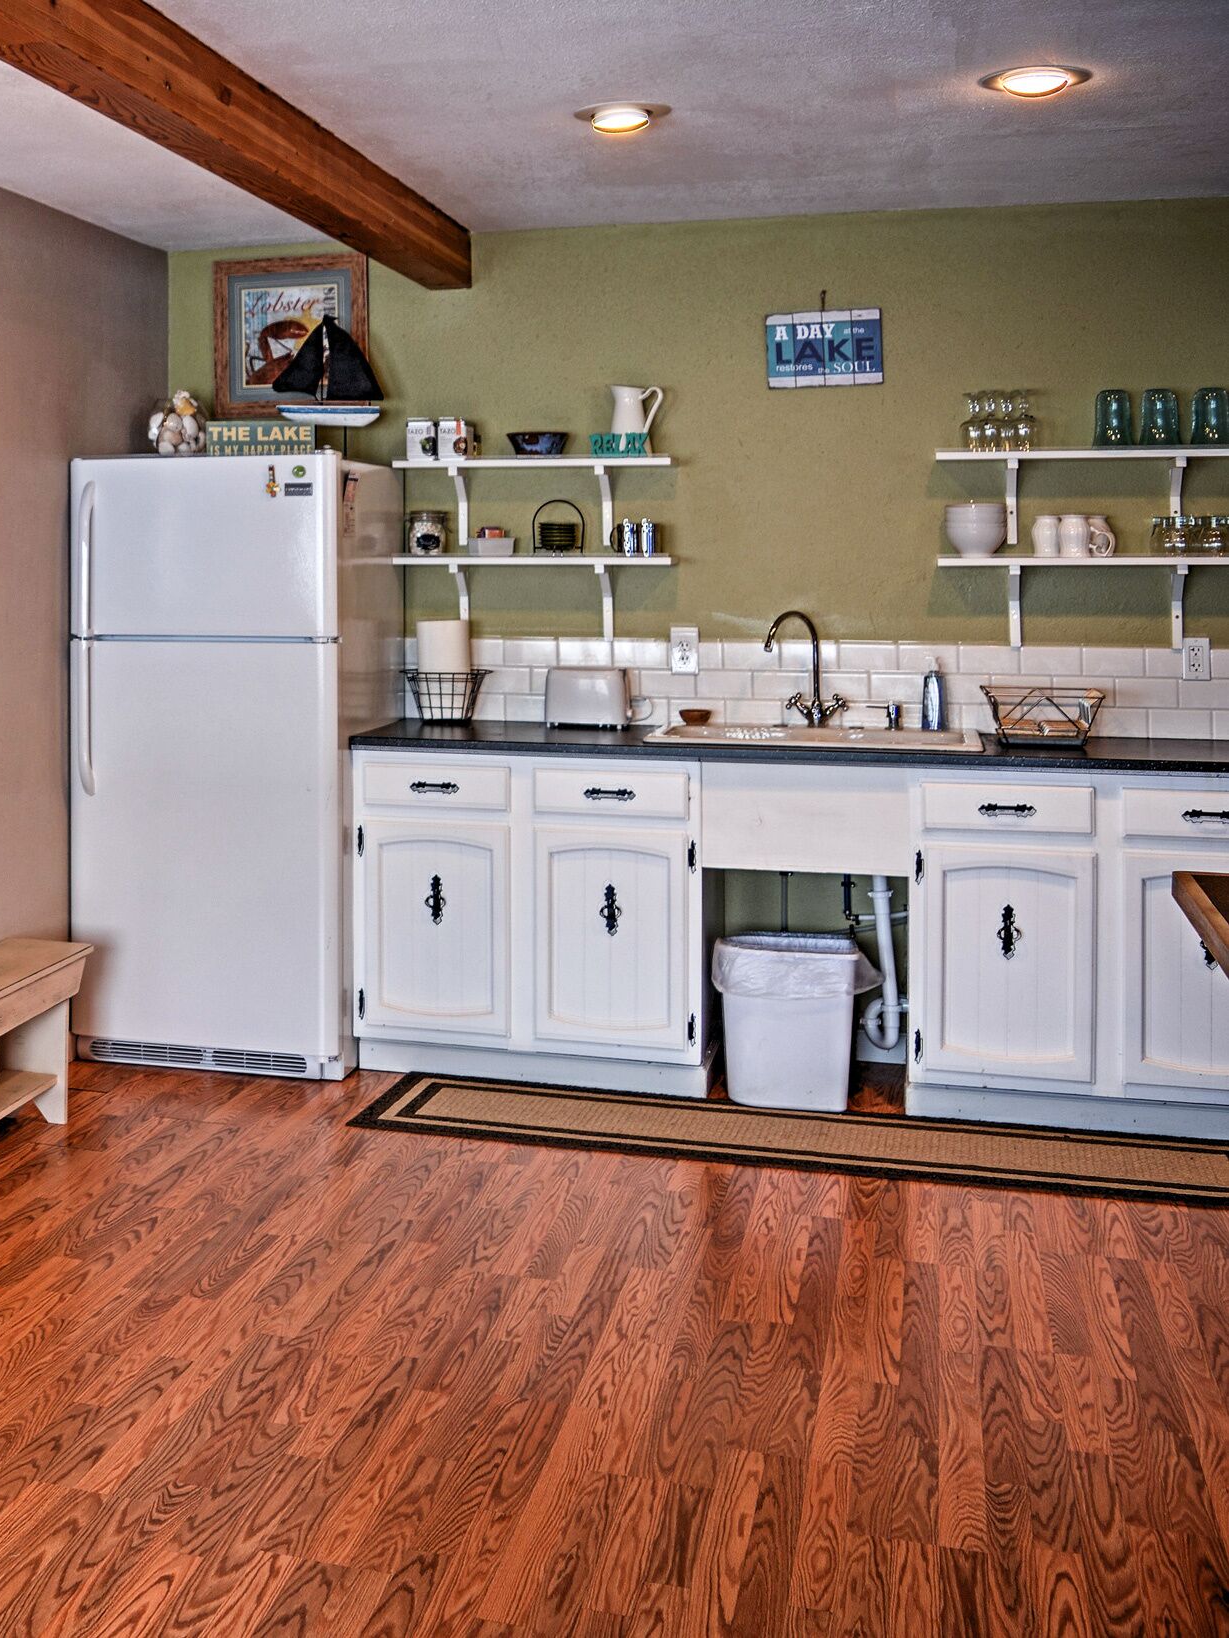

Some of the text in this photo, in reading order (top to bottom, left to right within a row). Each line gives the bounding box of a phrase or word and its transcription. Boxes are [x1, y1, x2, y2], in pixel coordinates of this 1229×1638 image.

[248, 291, 321, 318] Lobster
[774, 326, 789, 341] A
[796, 323, 835, 340] DAY
[775, 337, 875, 365] LAKE
[776, 363, 813, 372] restores
[833, 360, 876, 374] SOUL
[209, 426, 312, 441] THE LAKE
[210, 444, 312, 456] IS MY HAPPY PLACE
[589, 432, 648, 458] RELAX
